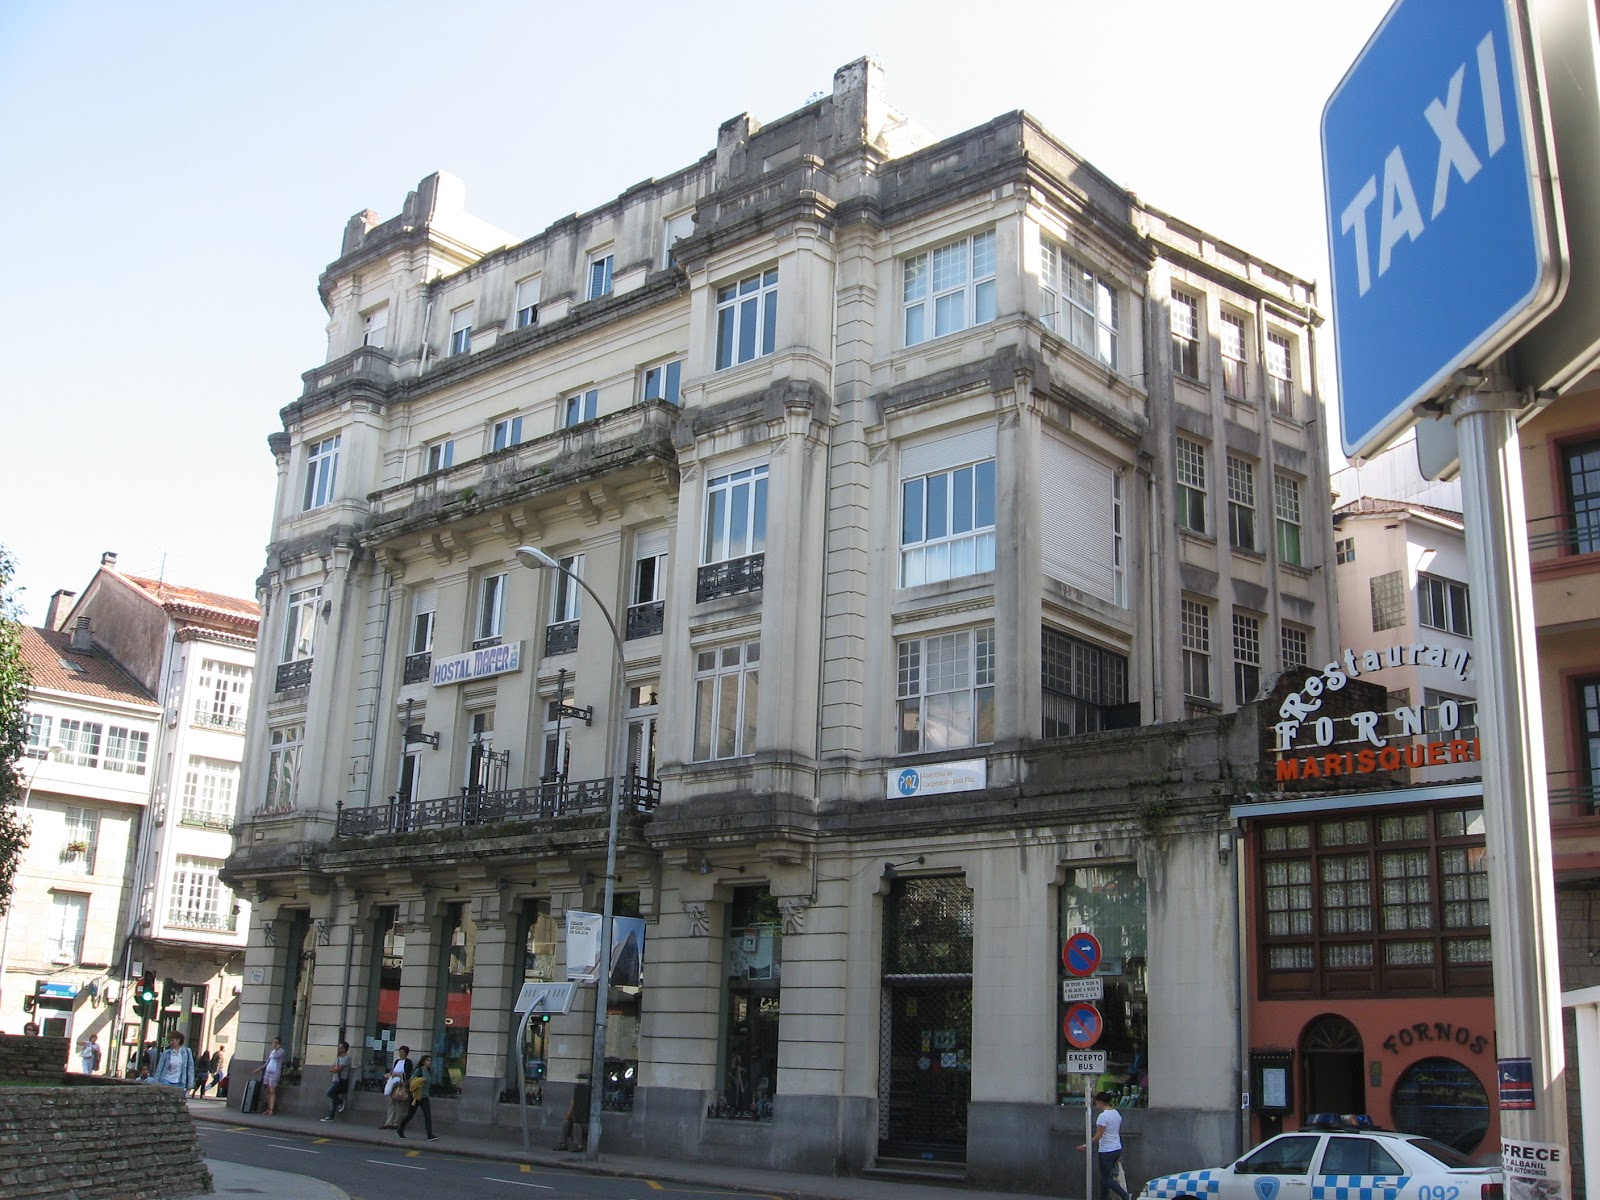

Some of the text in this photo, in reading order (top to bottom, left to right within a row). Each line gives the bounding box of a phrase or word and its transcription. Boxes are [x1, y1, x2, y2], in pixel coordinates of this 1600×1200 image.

[1341, 30, 1505, 298] TAXI
[433, 659, 471, 683] HOSTAL
[1275, 700, 1479, 750] FORNO
[1276, 738, 1480, 781] MARISQUERI
[900, 774, 917, 789] PAZ
[1383, 1023, 1488, 1054] FORNOS
[1501, 1144, 1560, 1162] FRECE
[1510, 1159, 1546, 1170] ALBAÑIL
[1418, 1185, 1460, 1200] 092
